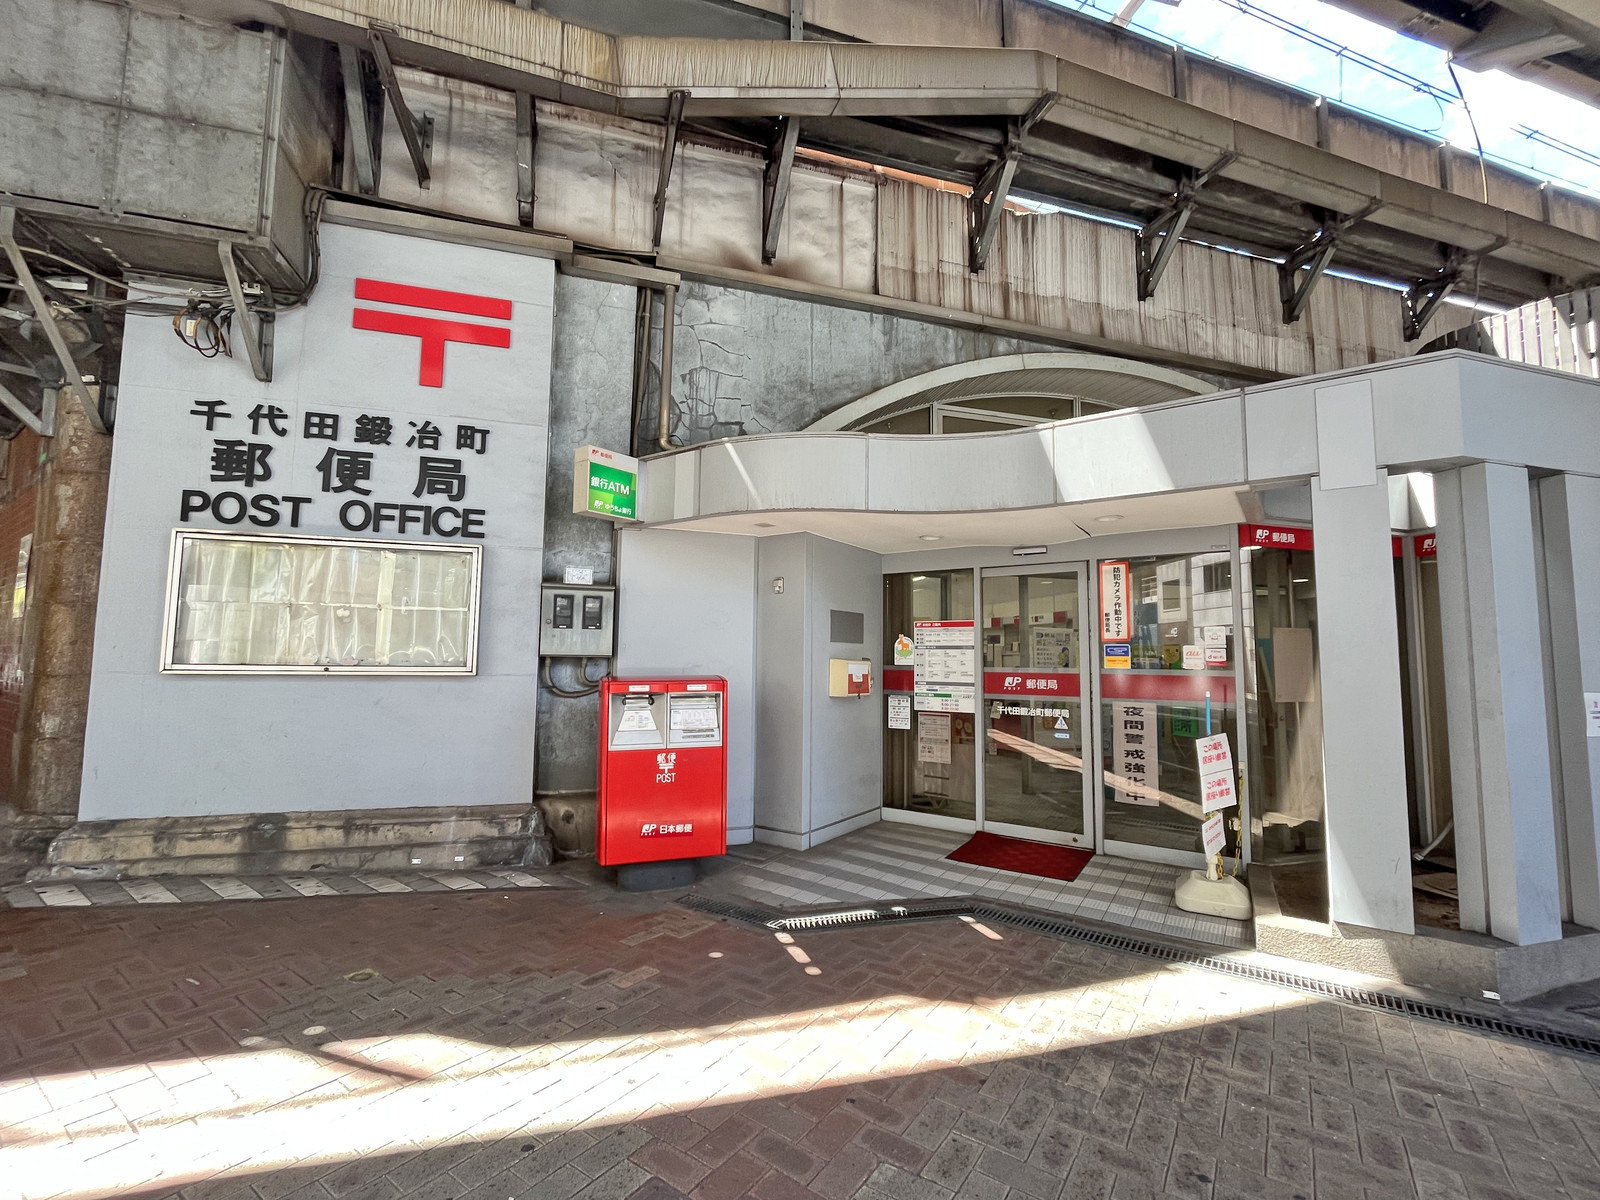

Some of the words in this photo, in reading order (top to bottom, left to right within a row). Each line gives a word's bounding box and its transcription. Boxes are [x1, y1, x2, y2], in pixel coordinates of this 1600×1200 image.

[190, 400, 490, 454] 千代田鍛冶町
[210, 439, 466, 502] 郵便局
[591, 476, 630, 495] 銀行ATM
[180, 489, 312, 528] POST
[339, 499, 486, 539] OFFICE
[1272, 532, 1296, 544] 郵便局
[1113, 567, 1123, 637] 防犯カメラ作動中です
[1026, 679, 1058, 690] 郵便局
[997, 705, 1070, 719] 千代田鍛冶町郵便局
[656, 752, 677, 765] 郵便
[656, 773, 676, 783] POST
[659, 824, 693, 834] 日本郵便
